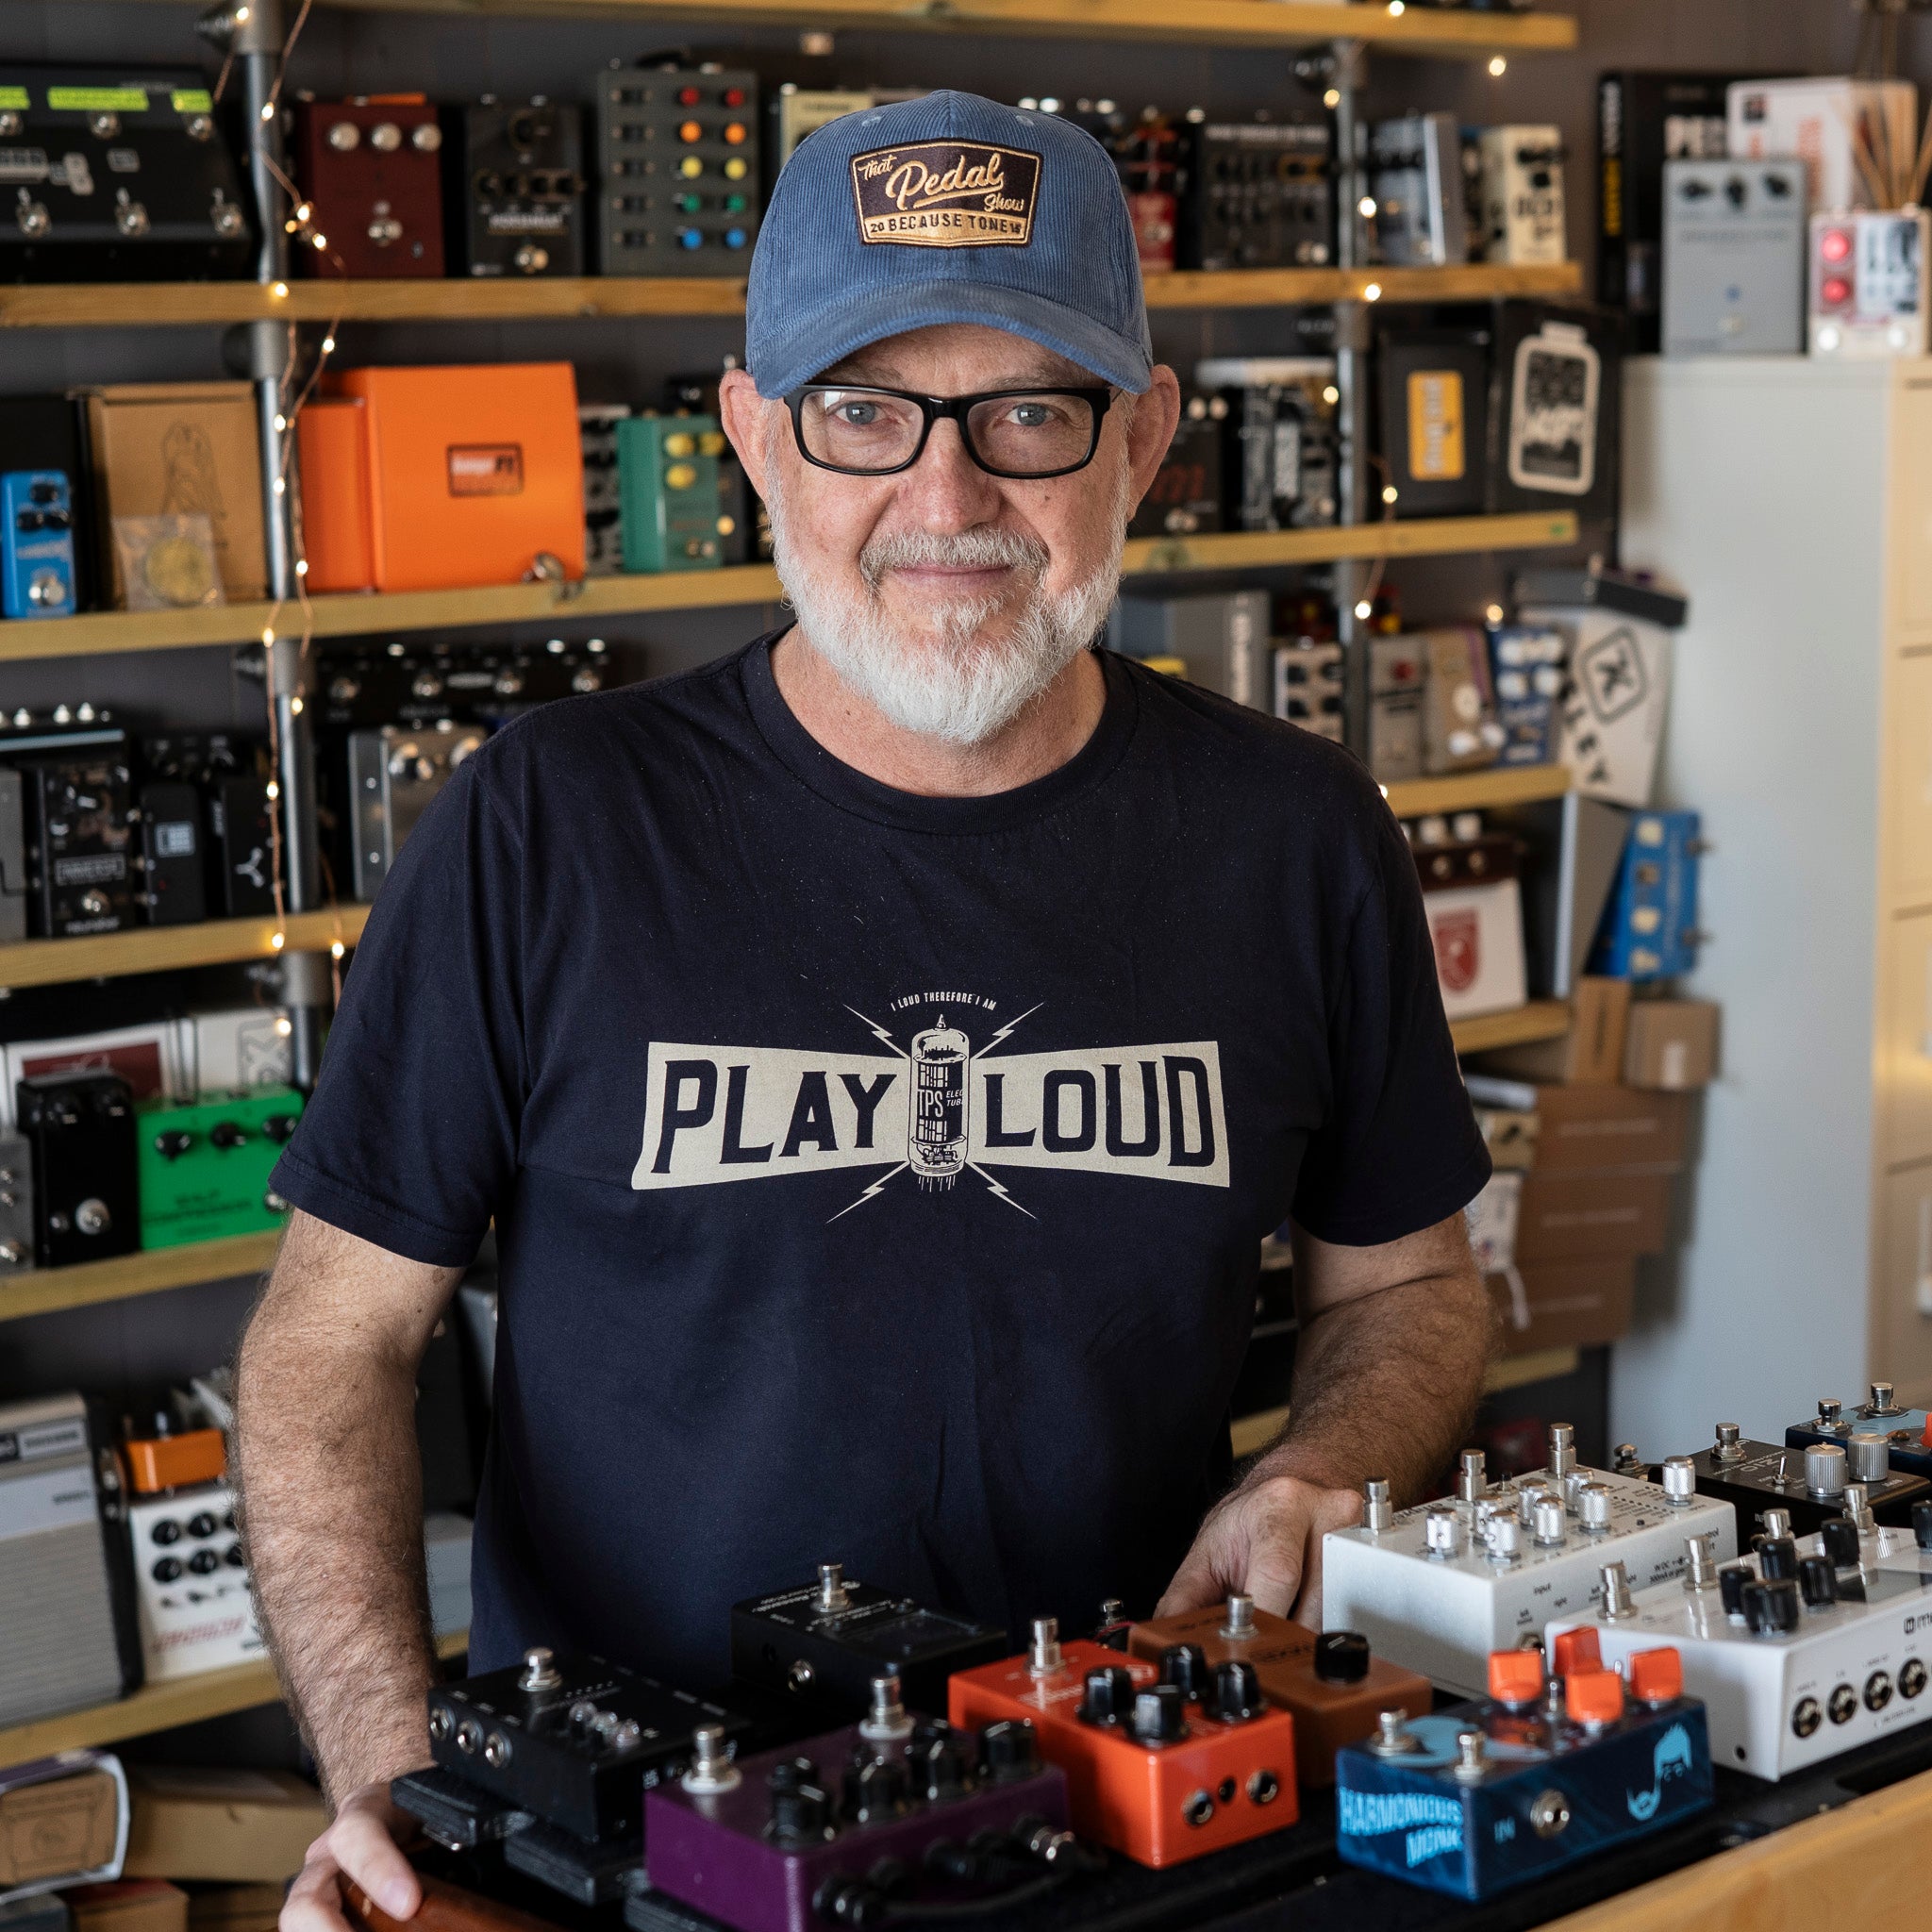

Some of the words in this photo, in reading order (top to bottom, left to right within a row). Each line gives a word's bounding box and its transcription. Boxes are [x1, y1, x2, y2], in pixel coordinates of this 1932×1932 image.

[857, 154, 897, 181] That
[885, 152, 1005, 211] Pedal
[984, 192, 1024, 212] Show
[870, 222, 885, 233] 20
[889, 212, 962, 232] BECAUSE
[968, 214, 1008, 233] TONE
[891, 1002, 896, 1012] I
[897, 993, 921, 1008] LOUD
[924, 991, 974, 1004] THEREFORE
[974, 995, 980, 1006] I
[982, 998, 997, 1011] AM
[650, 1058, 898, 1174] PLAY
[917, 1089, 943, 1118] TPS
[946, 1098, 963, 1108] TUB
[983, 1055, 1216, 1168] LOUD
[1494, 1816, 1516, 1844] IN
